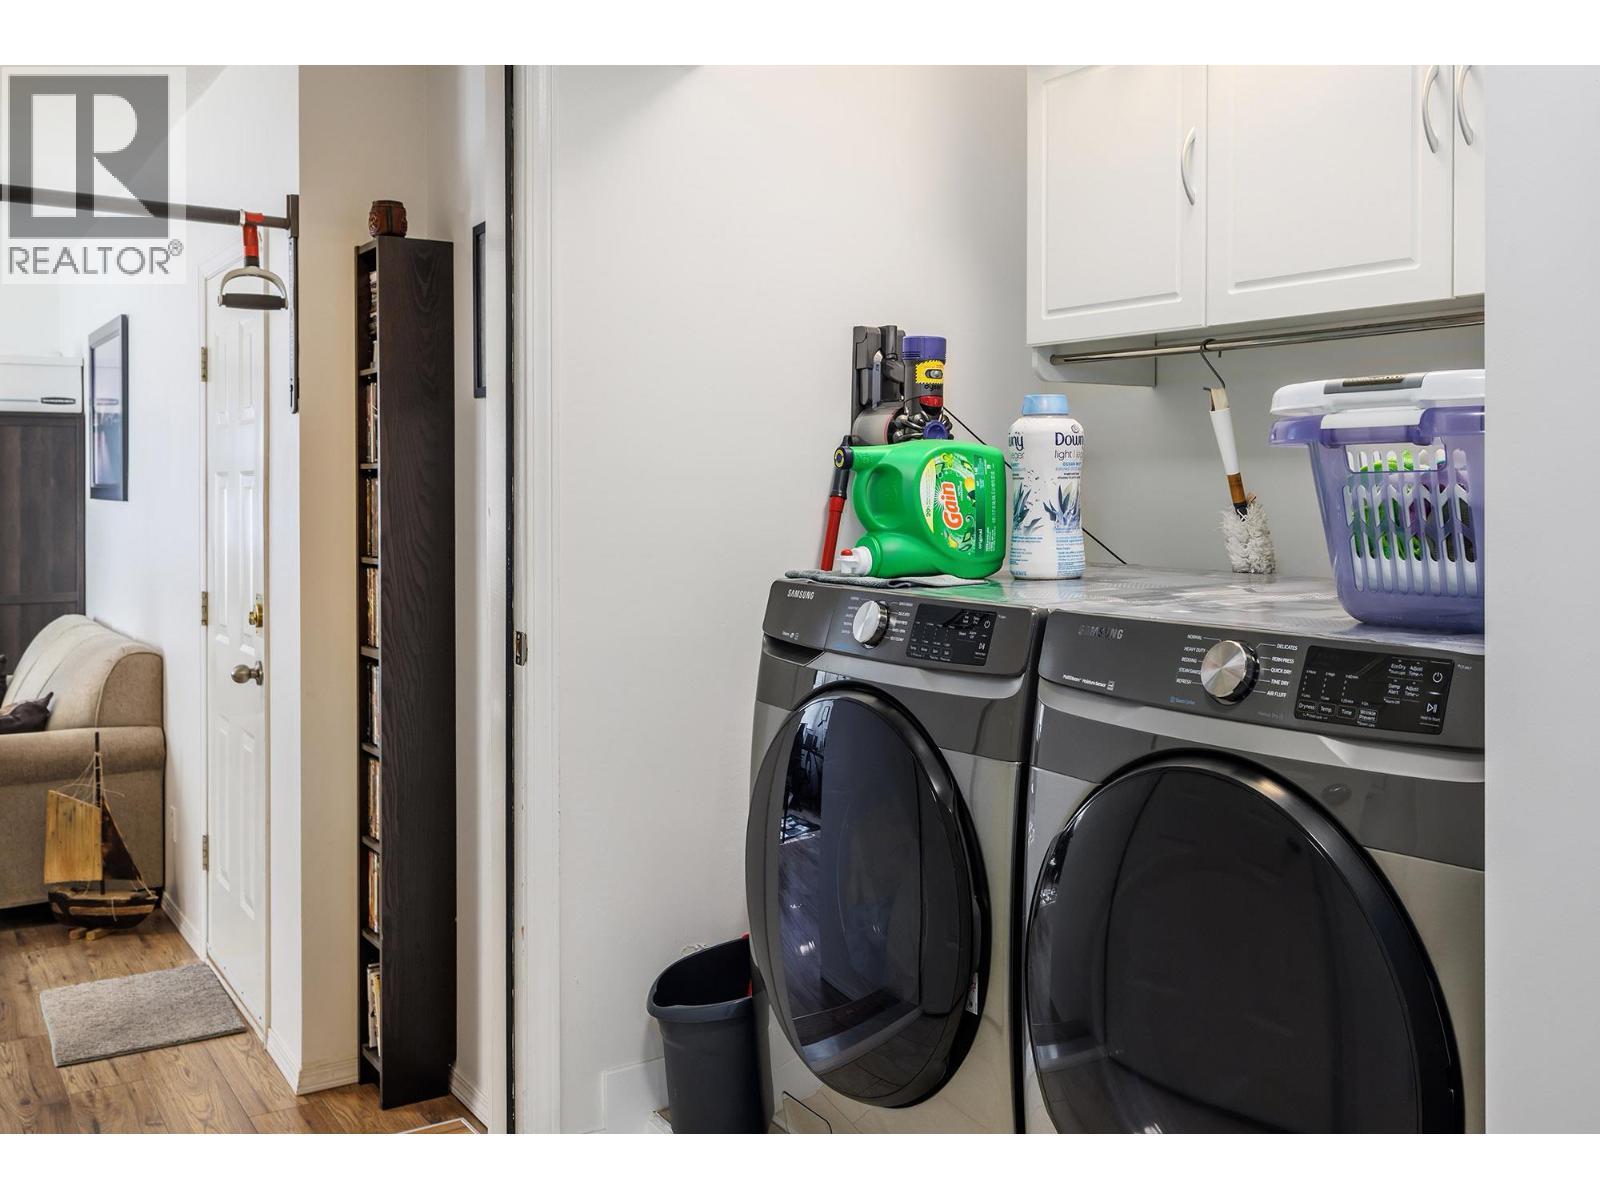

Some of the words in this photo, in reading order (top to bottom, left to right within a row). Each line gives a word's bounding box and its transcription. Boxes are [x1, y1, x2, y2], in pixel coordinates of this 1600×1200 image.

[941, 481, 963, 529] Gain
[786, 588, 816, 600] SAMSUNG
[1276, 643, 1298, 651] DELICATES
[1298, 702, 1315, 710] Dryness
